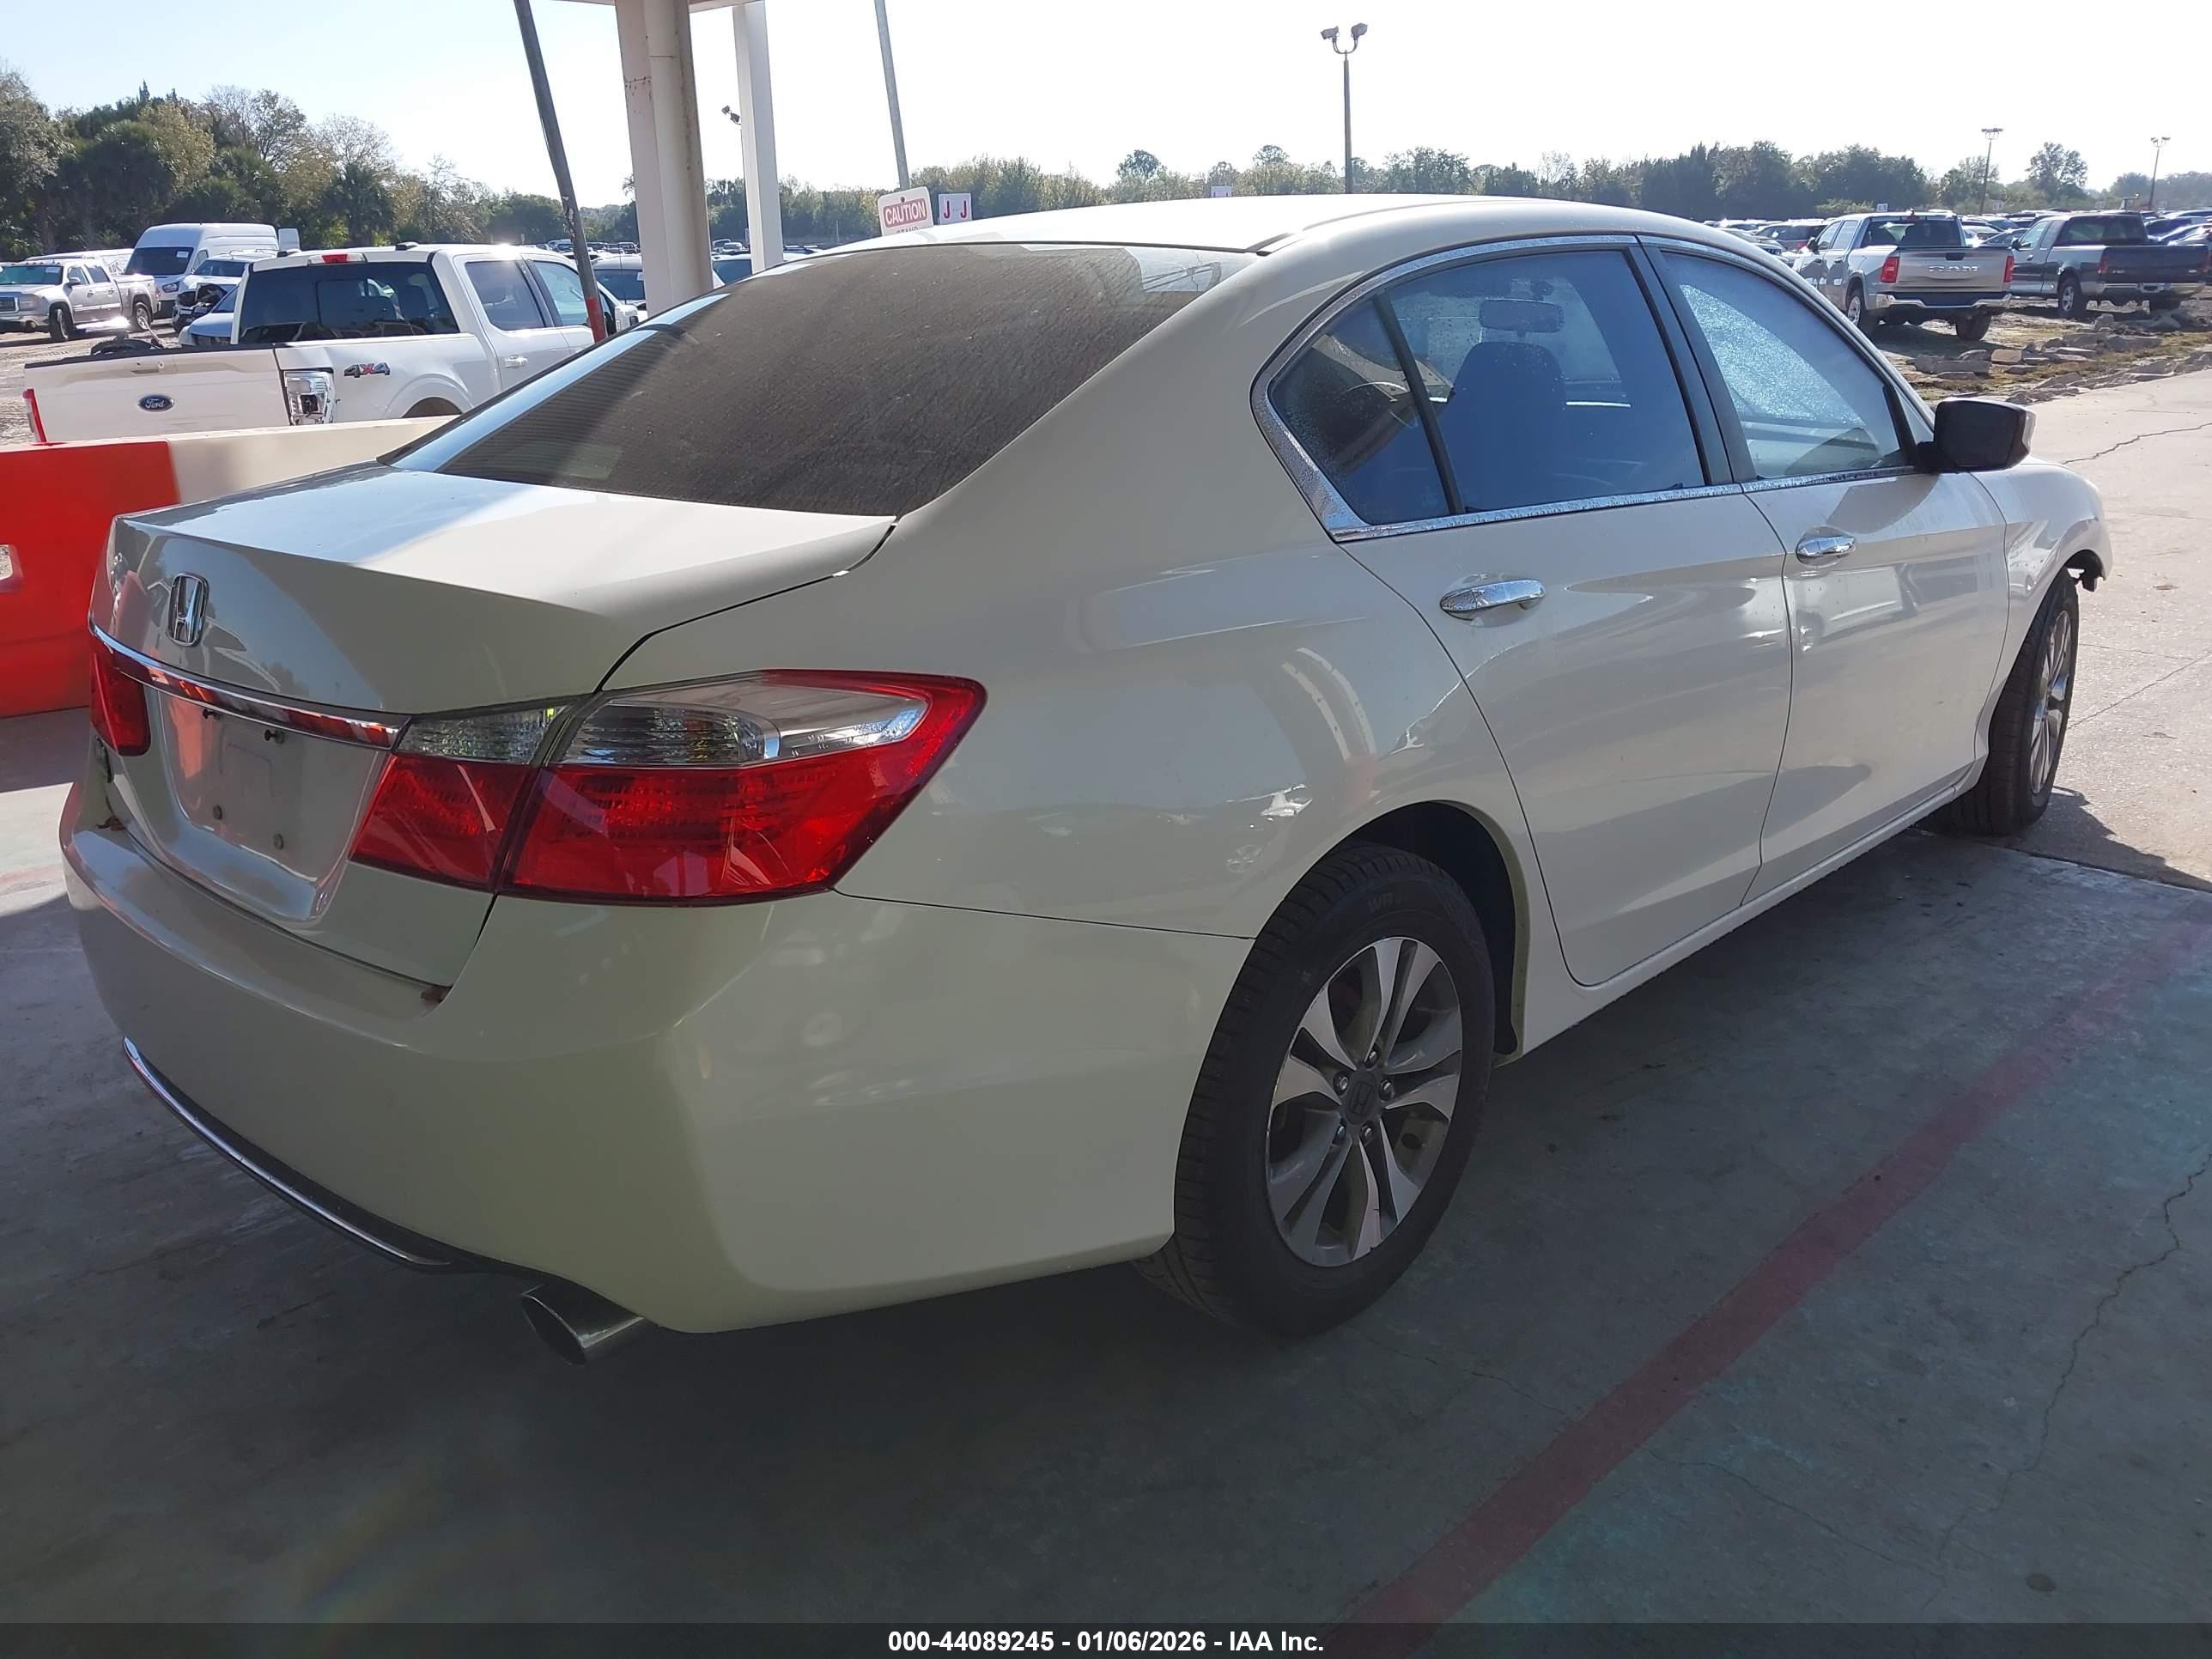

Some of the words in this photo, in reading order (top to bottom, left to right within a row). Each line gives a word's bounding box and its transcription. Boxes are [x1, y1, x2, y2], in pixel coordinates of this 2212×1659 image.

[884, 200, 926, 225] CAUTION
[943, 200, 951, 219] J
[960, 200, 968, 219] J
[144, 398, 166, 409] Ford
